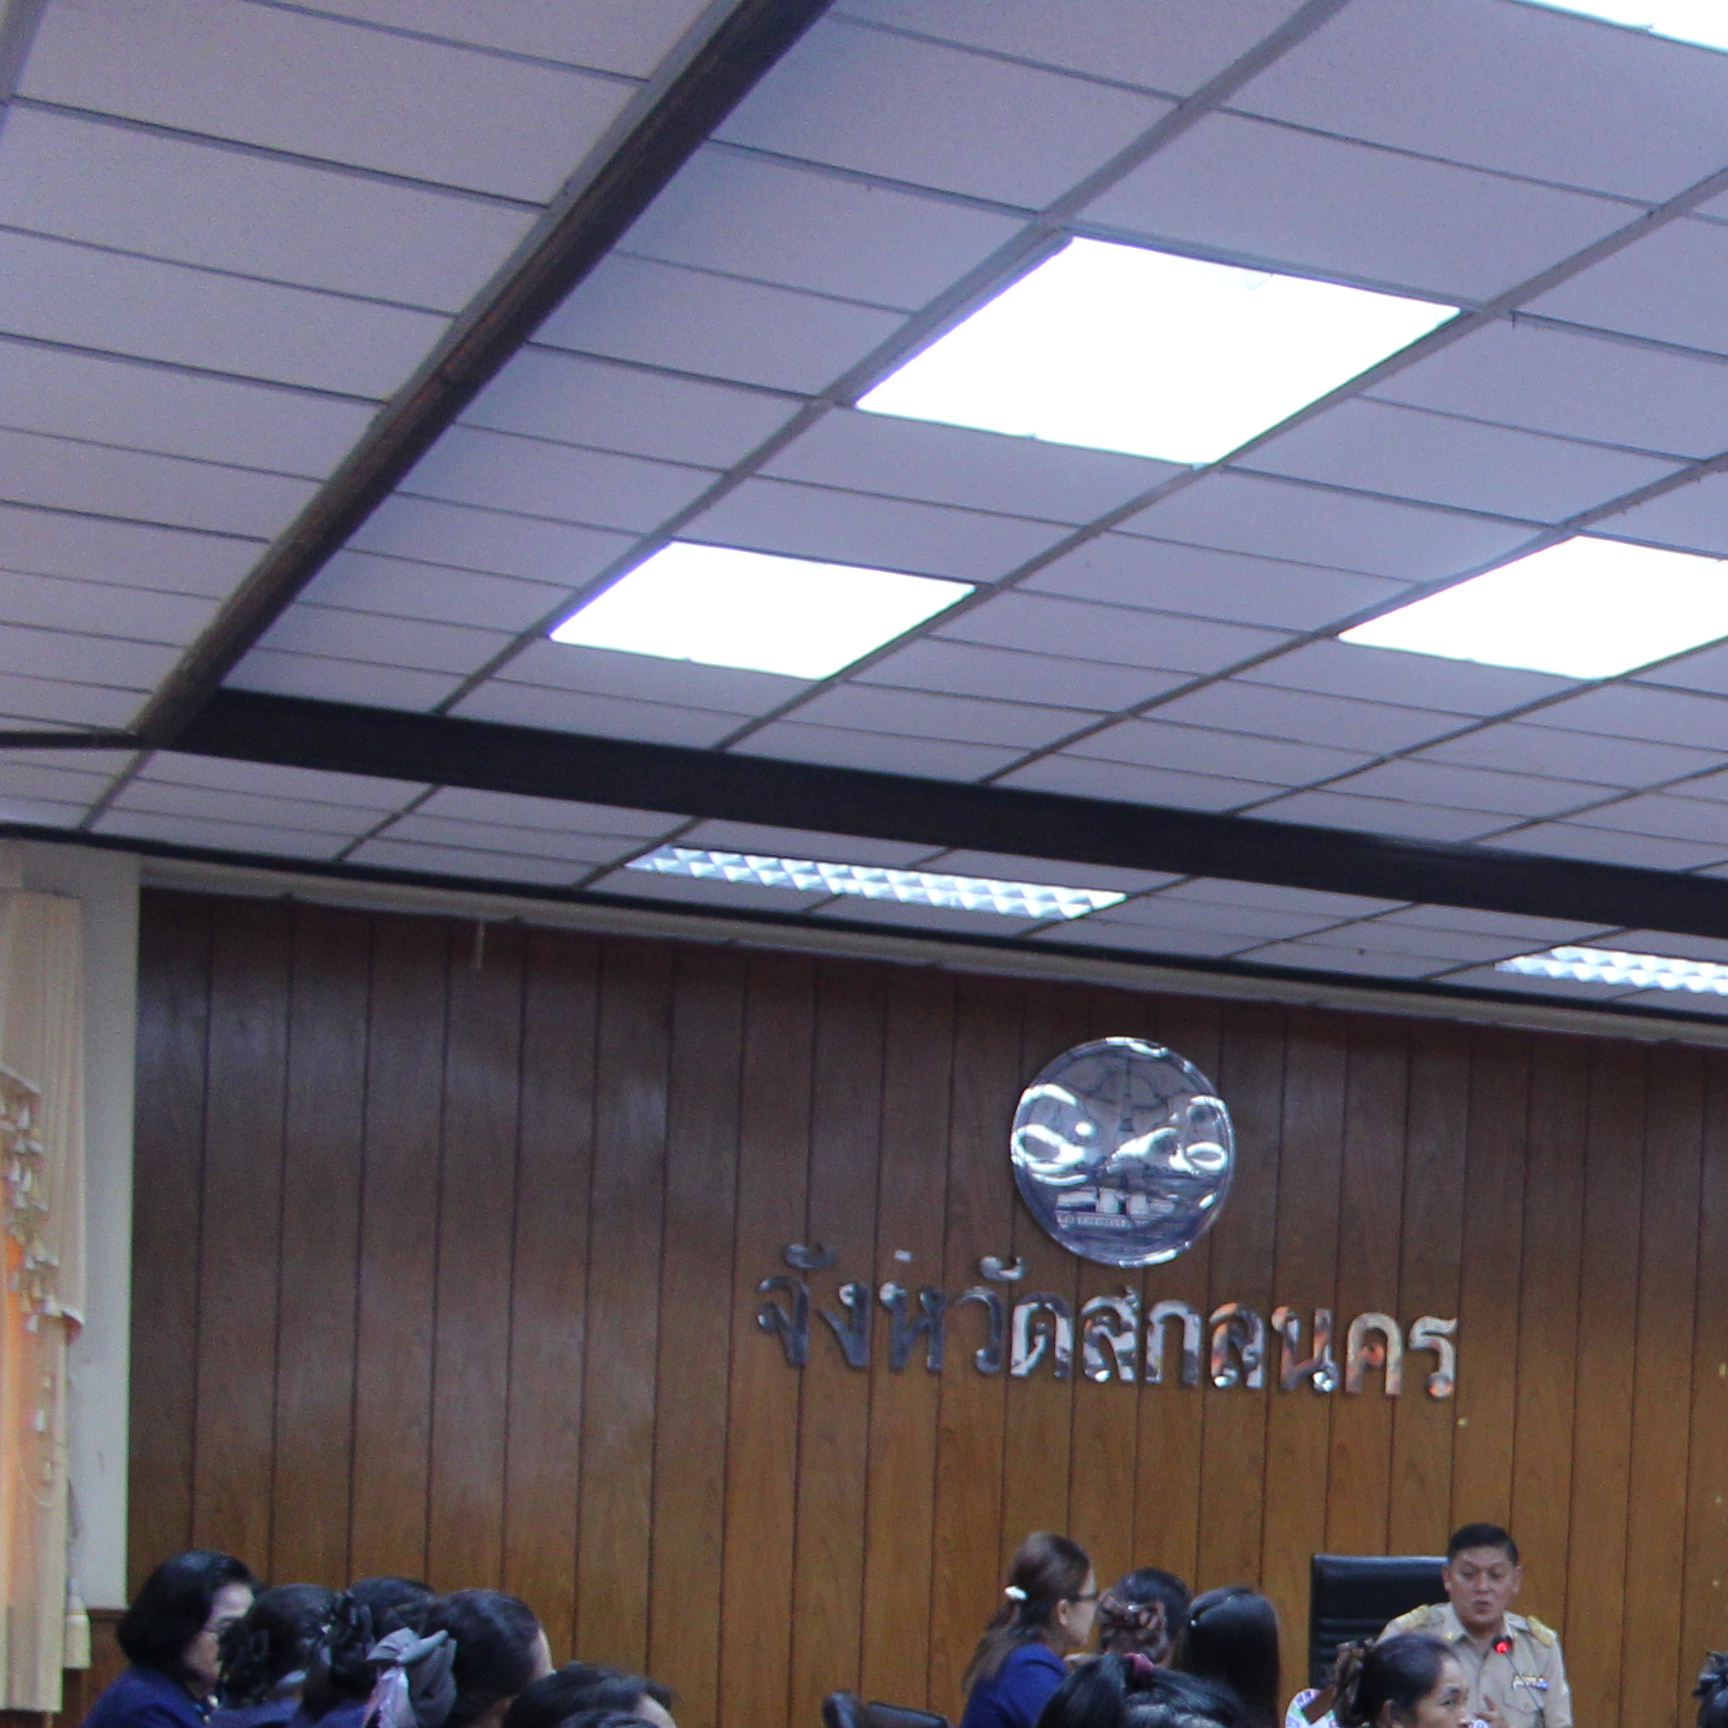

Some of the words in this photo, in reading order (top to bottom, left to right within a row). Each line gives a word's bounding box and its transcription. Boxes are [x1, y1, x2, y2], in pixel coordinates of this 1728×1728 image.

[756, 1243, 1459, 1398] จังหวัดสกลนคร
